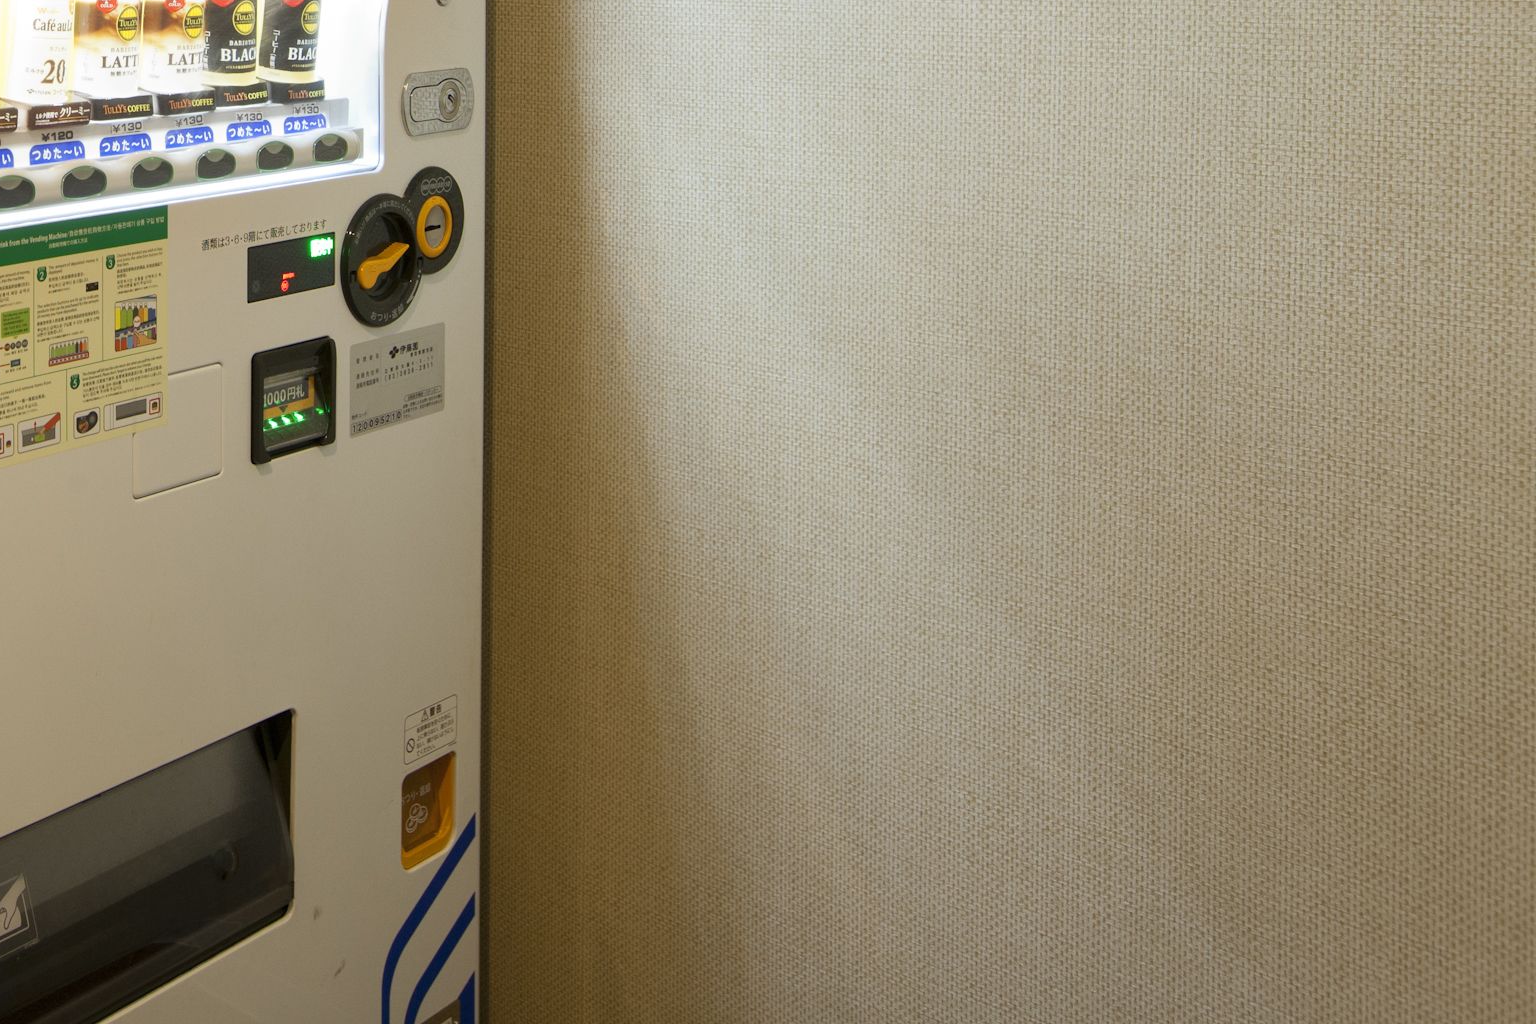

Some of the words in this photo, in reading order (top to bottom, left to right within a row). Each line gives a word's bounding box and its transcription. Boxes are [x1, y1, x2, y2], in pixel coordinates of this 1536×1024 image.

[128, 103, 151, 112] COFFEE
[191, 97, 214, 107] COFFEE
[59, 106, 91, 118] クリーミー
[295, 105, 320, 114] ¥130
[176, 115, 203, 126] ¥130
[237, 112, 262, 121] ¥130
[114, 121, 143, 133] ¥130
[41, 130, 74, 142] ¥120
[9, 239, 20, 247] from
[21, 237, 29, 246] the
[29, 234, 48, 245] Vending
